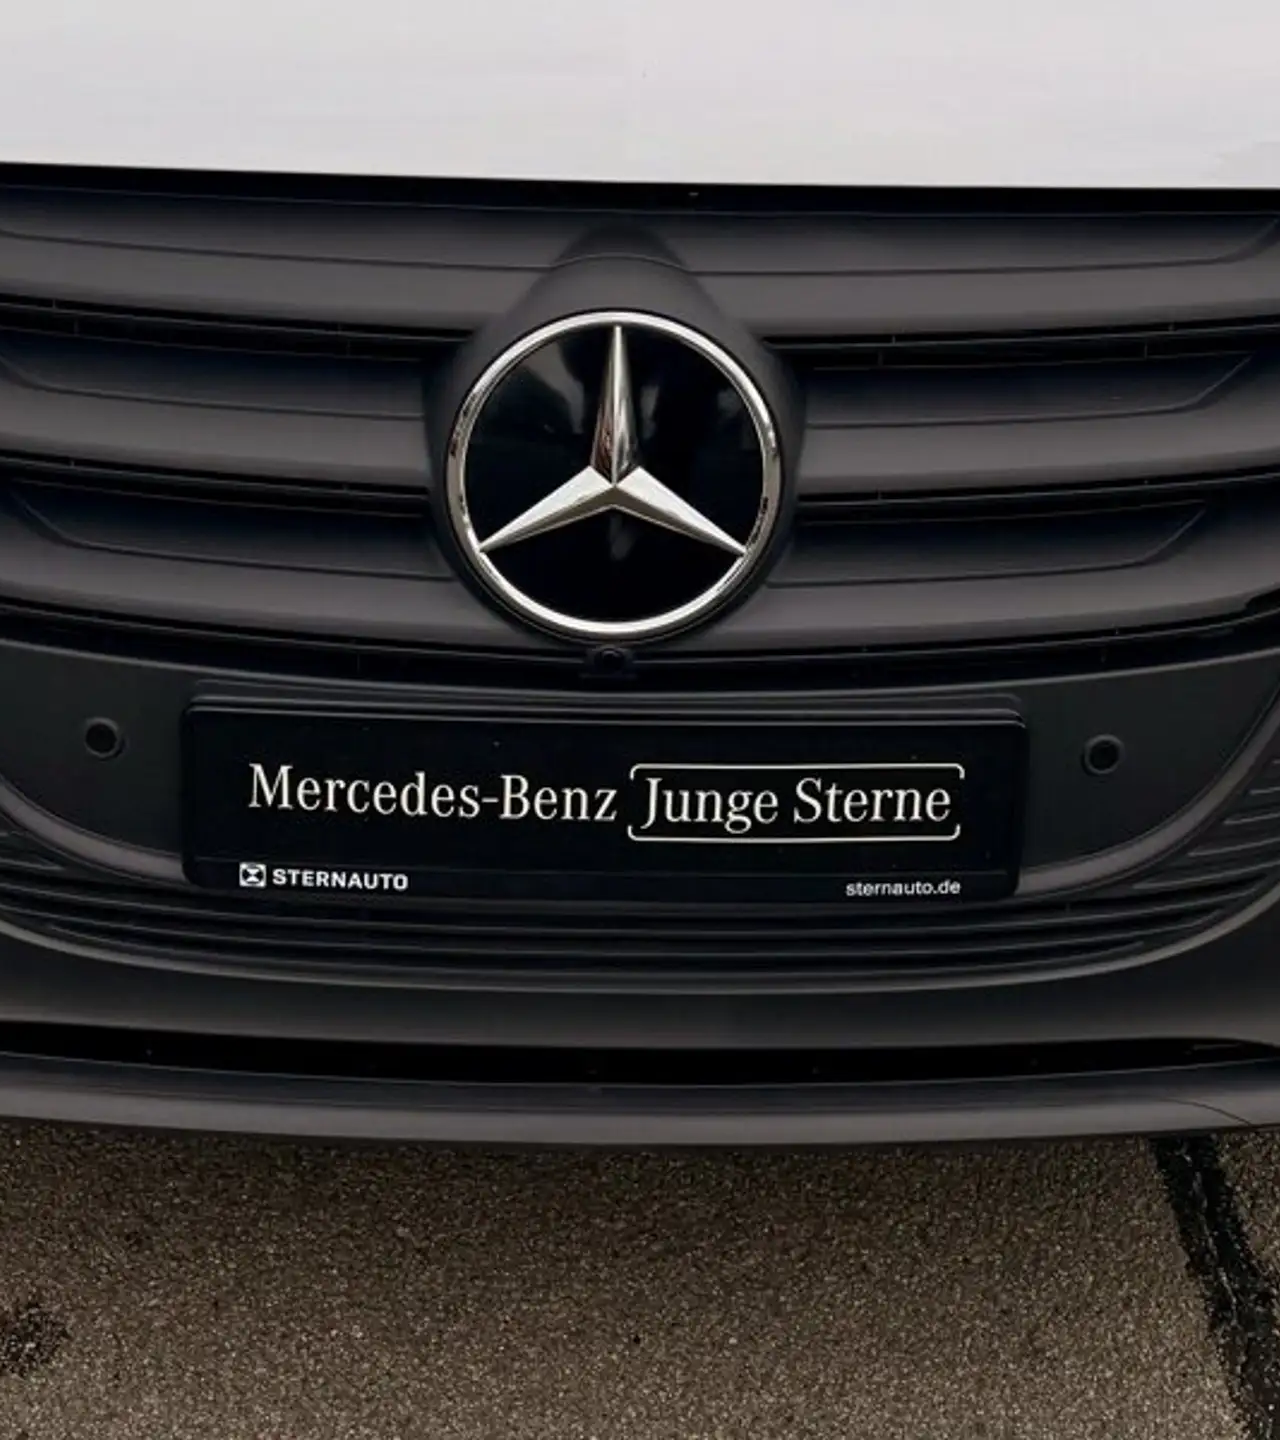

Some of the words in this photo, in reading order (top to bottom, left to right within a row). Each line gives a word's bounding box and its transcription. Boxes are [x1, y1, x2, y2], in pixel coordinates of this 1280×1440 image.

[247, 762, 618, 822] Mercedes-Benz
[640, 777, 780, 835] Junge
[792, 777, 952, 824] Sterne
[271, 867, 410, 892] STERNAUTO
[845, 879, 962, 897] sternauto.de
